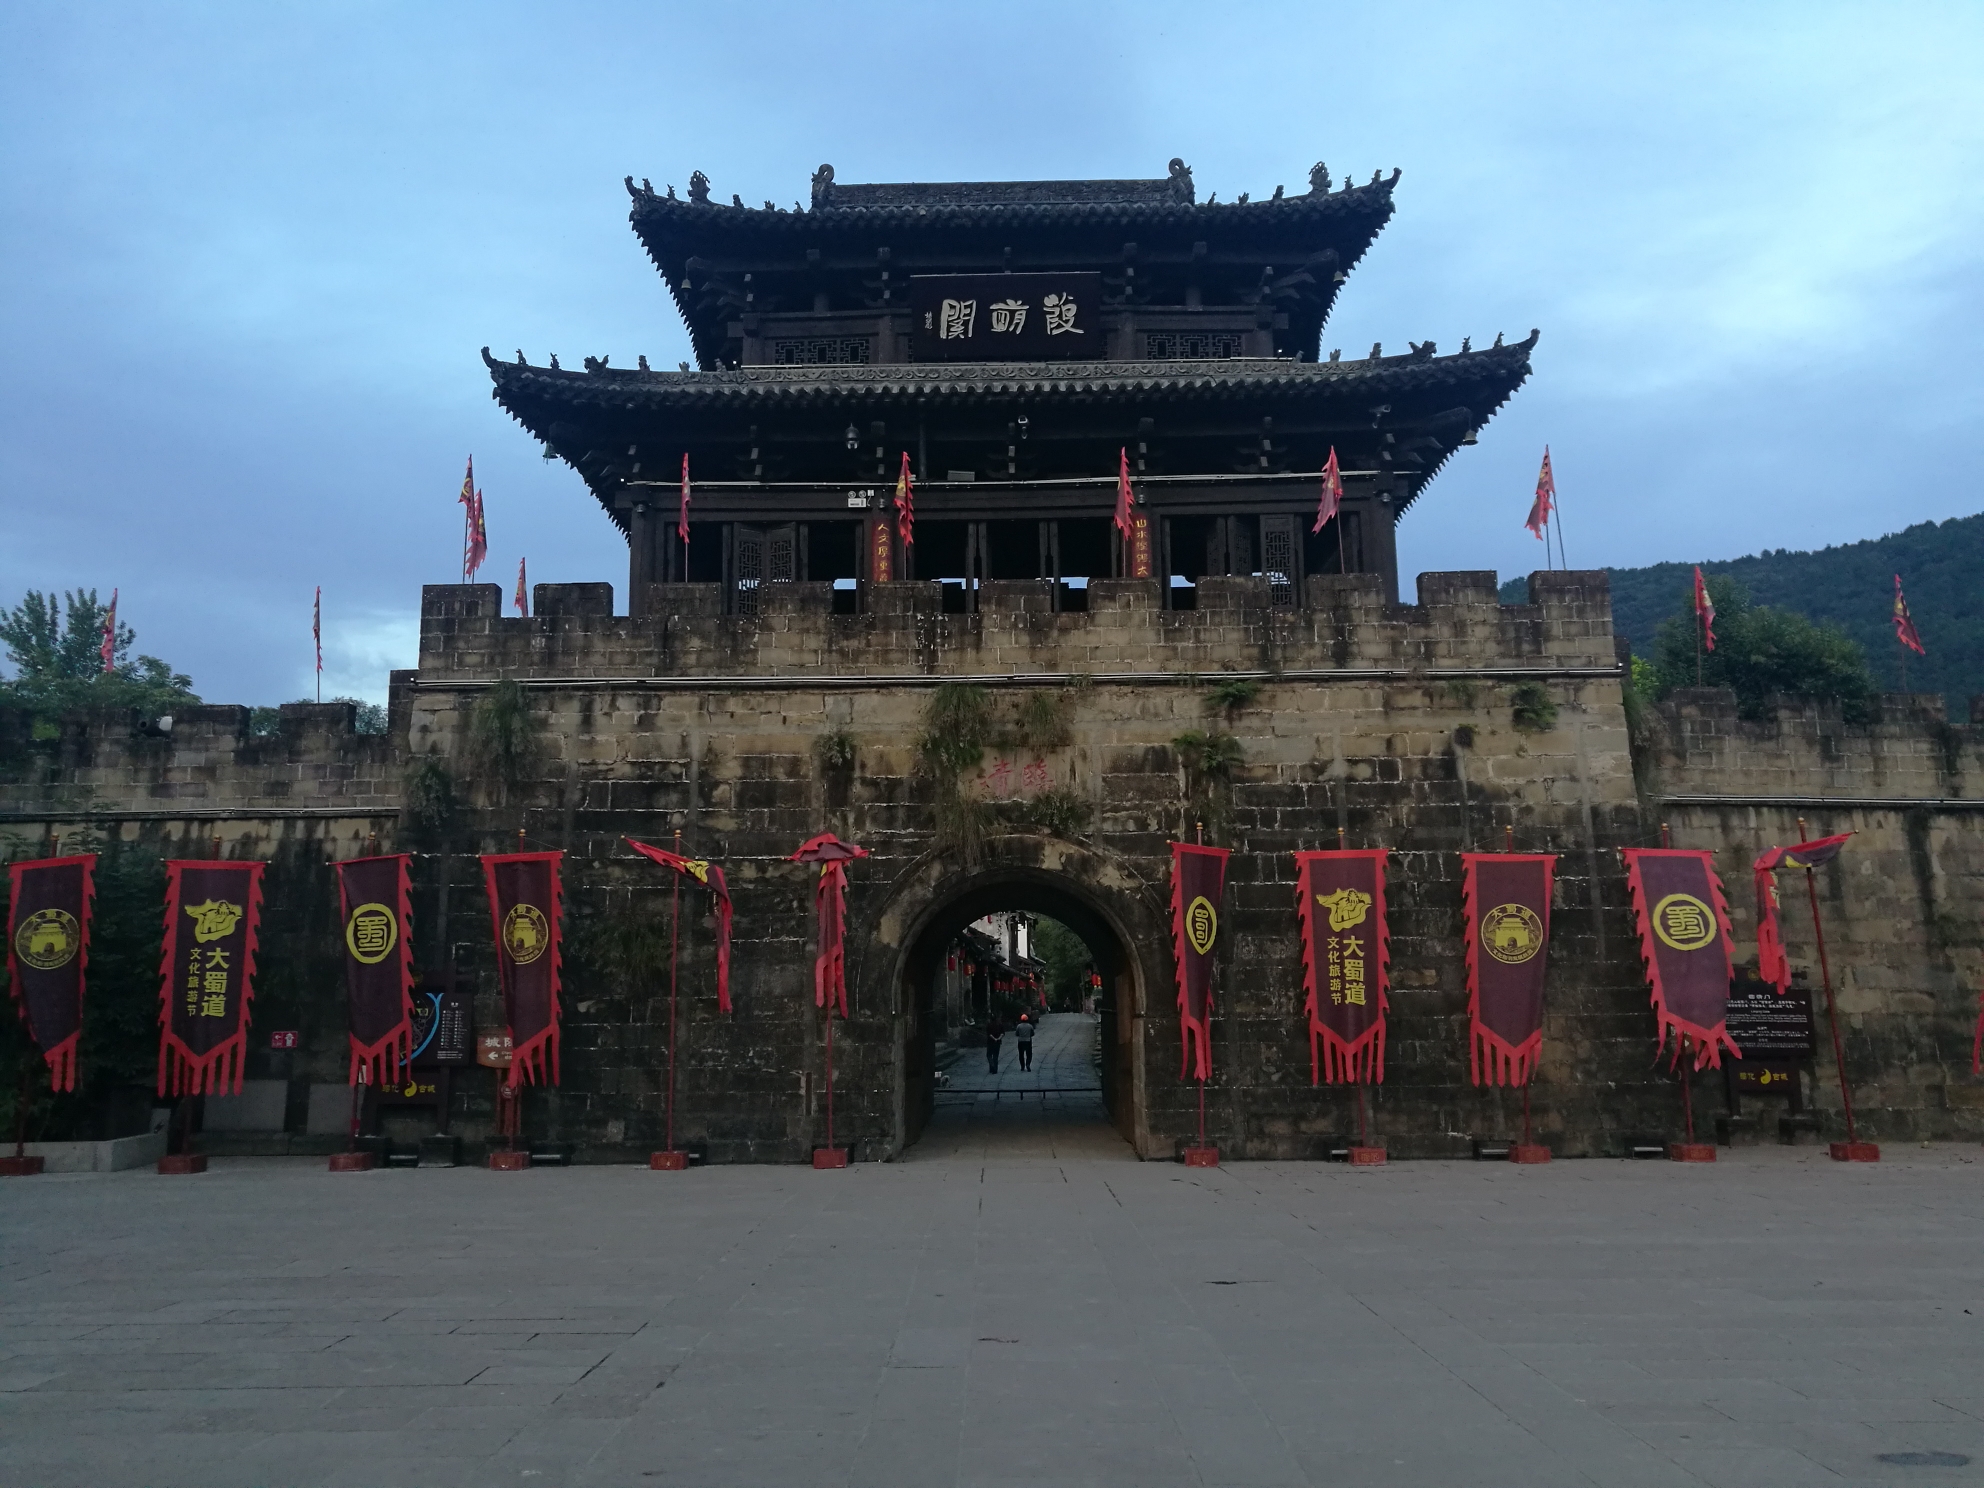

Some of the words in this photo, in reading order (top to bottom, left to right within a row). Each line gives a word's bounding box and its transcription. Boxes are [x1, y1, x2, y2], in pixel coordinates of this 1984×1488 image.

[187, 948, 202, 1017] 文化旅游节
[201, 947, 230, 1018] 大蜀道
[1327, 936, 1342, 1005] 文化旅游节
[1343, 935, 1366, 1006] 大蜀道
